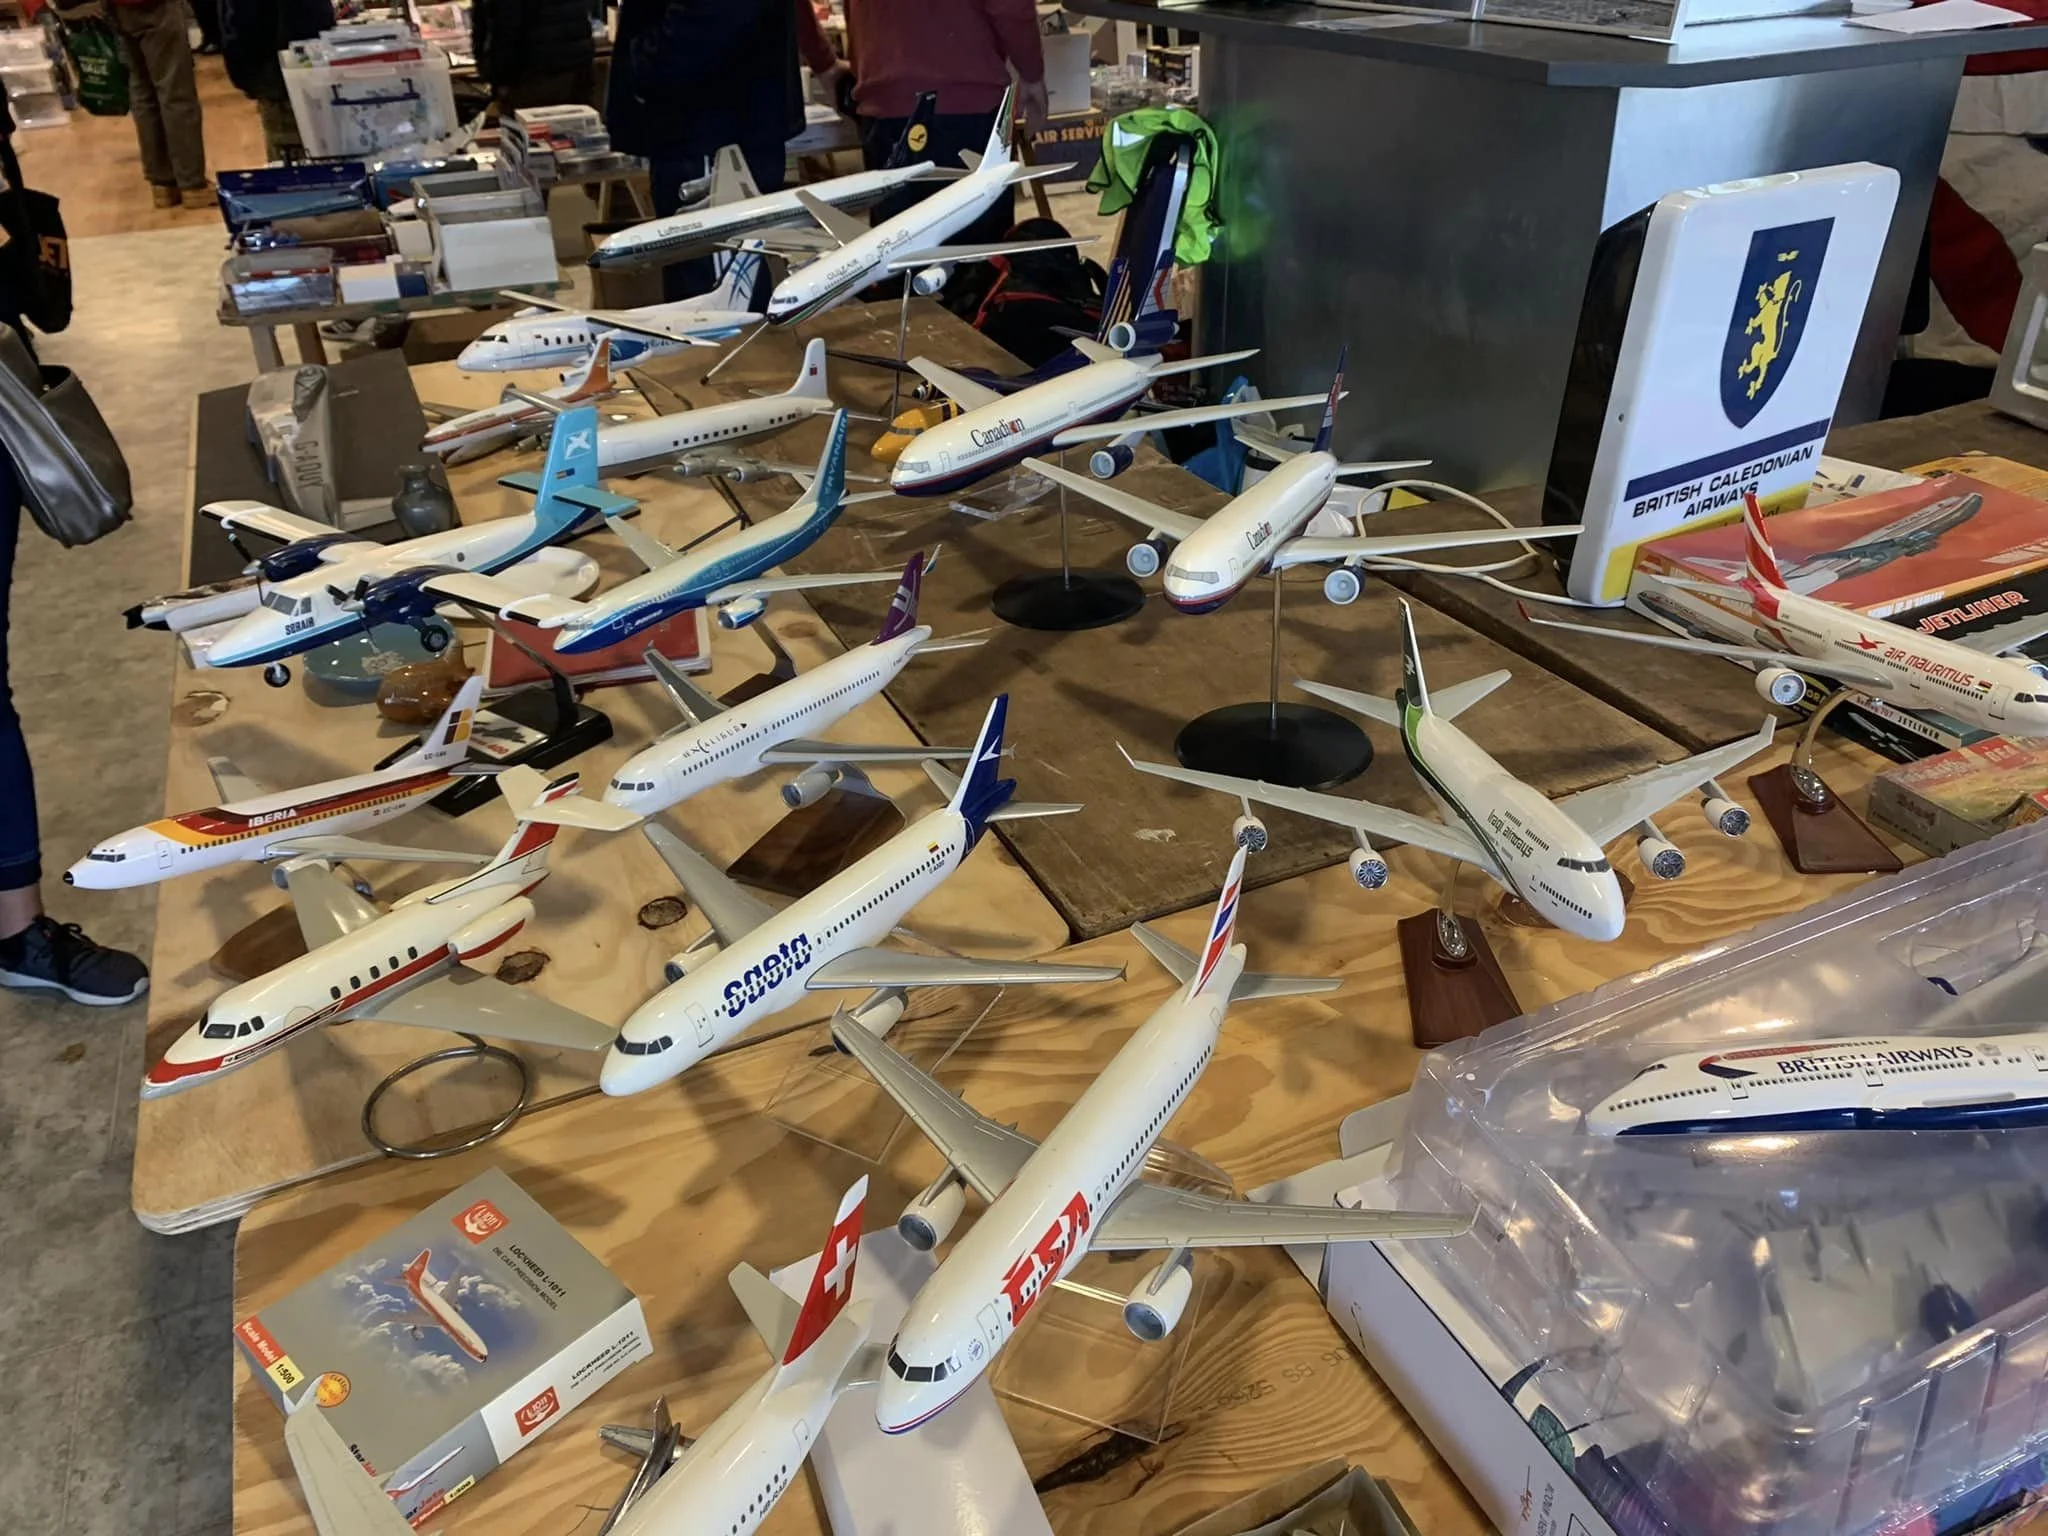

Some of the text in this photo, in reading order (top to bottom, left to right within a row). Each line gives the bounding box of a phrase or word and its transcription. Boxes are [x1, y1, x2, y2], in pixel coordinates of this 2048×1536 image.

[1034, 129, 1058, 144] AIR
[1632, 445, 1814, 519] BRITISH CALEDONIAN
[1683, 481, 1760, 520] AIRWAYS
[1916, 590, 2030, 636] JETLINER
[1897, 714, 1941, 741] JETLINER
[248, 808, 298, 829] IBERIA
[1776, 1045, 1974, 1076] BRITISH AIRWAYS
[509, 1244, 567, 1298] LOCKHEED L-1011
[275, 1363, 296, 1385] 1:500
